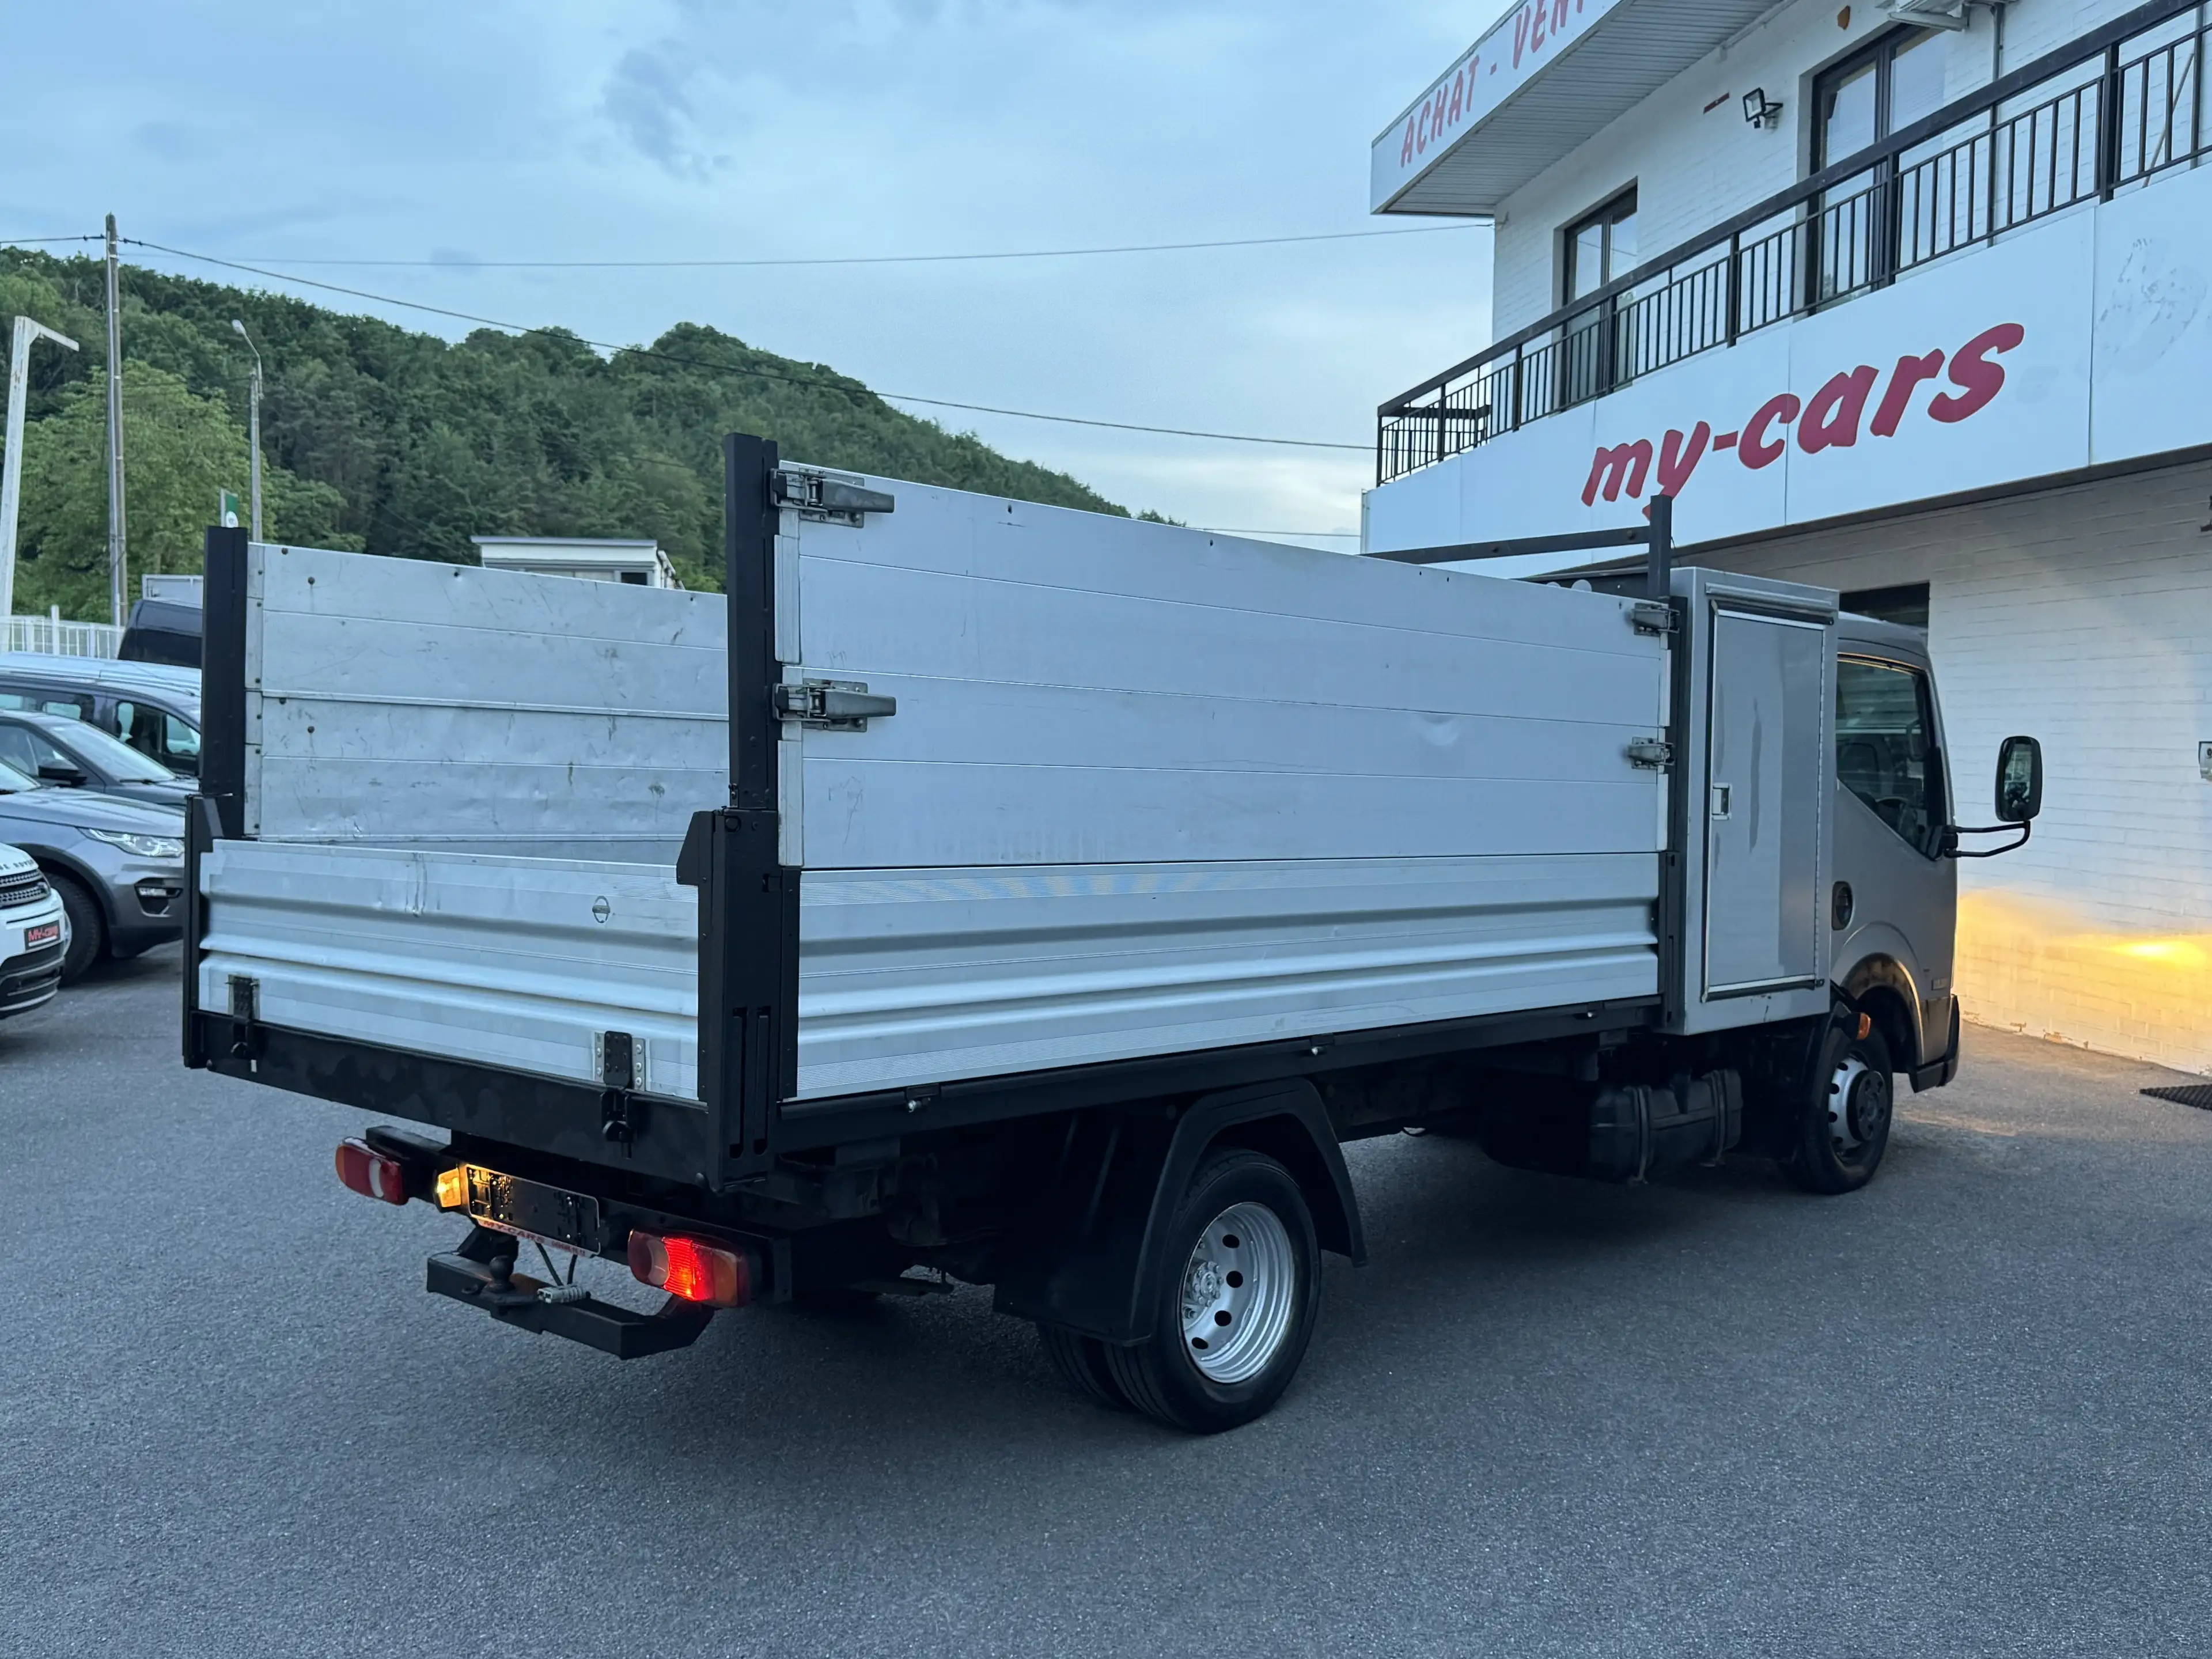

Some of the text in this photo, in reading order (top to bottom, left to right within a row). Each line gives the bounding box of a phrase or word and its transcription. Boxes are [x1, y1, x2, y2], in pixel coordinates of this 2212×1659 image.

[1400, 0, 1585, 168] ACHAT - VEN
[1581, 323, 2025, 522] my-cars
